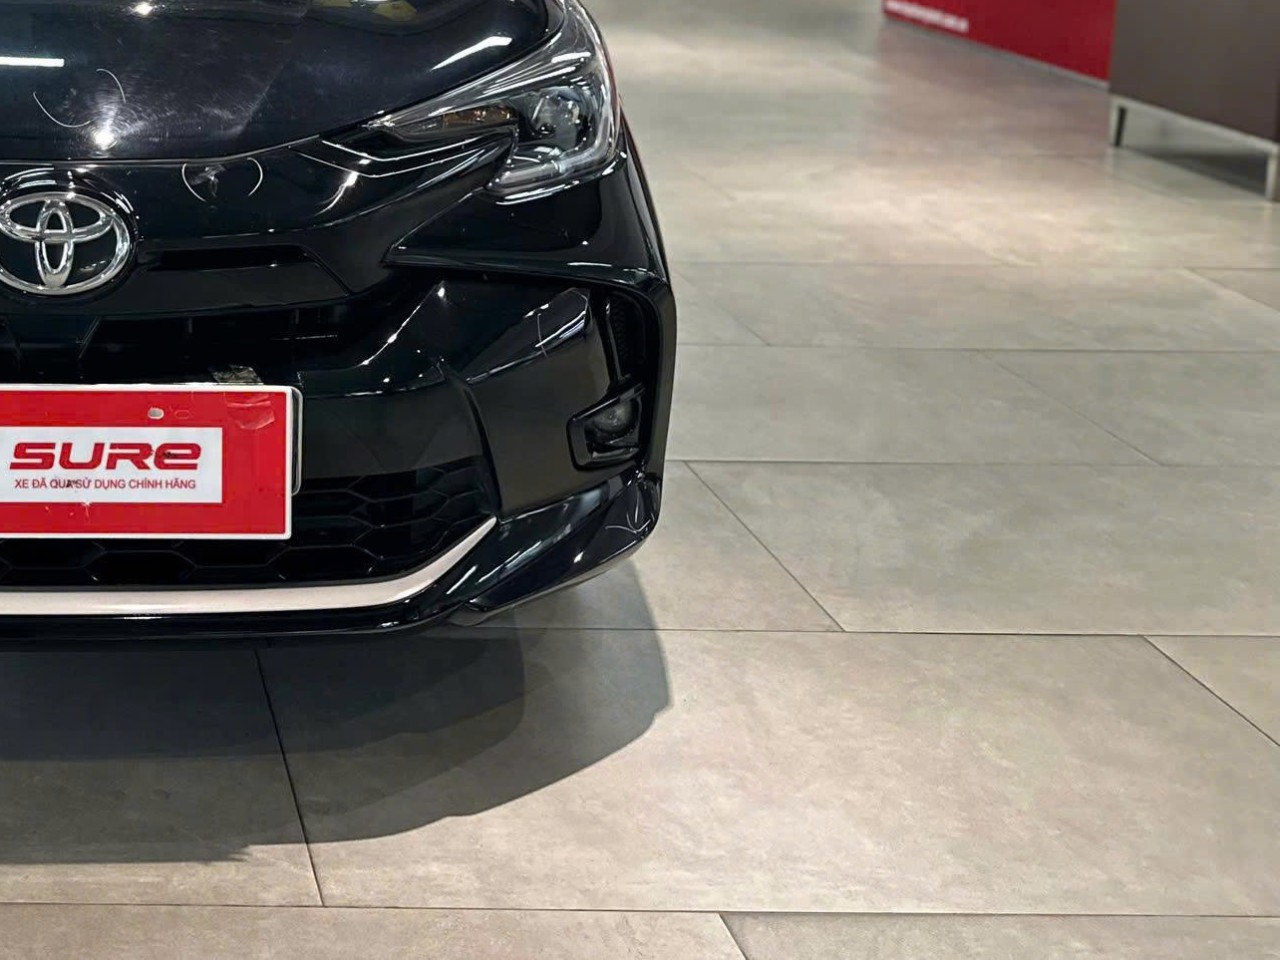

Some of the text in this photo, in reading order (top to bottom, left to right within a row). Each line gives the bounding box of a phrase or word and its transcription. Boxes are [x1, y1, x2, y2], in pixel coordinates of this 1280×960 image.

[14, 476, 196, 490] XE ĐÃ QUA SỬ DỤNG CHÍNH HÃNG
